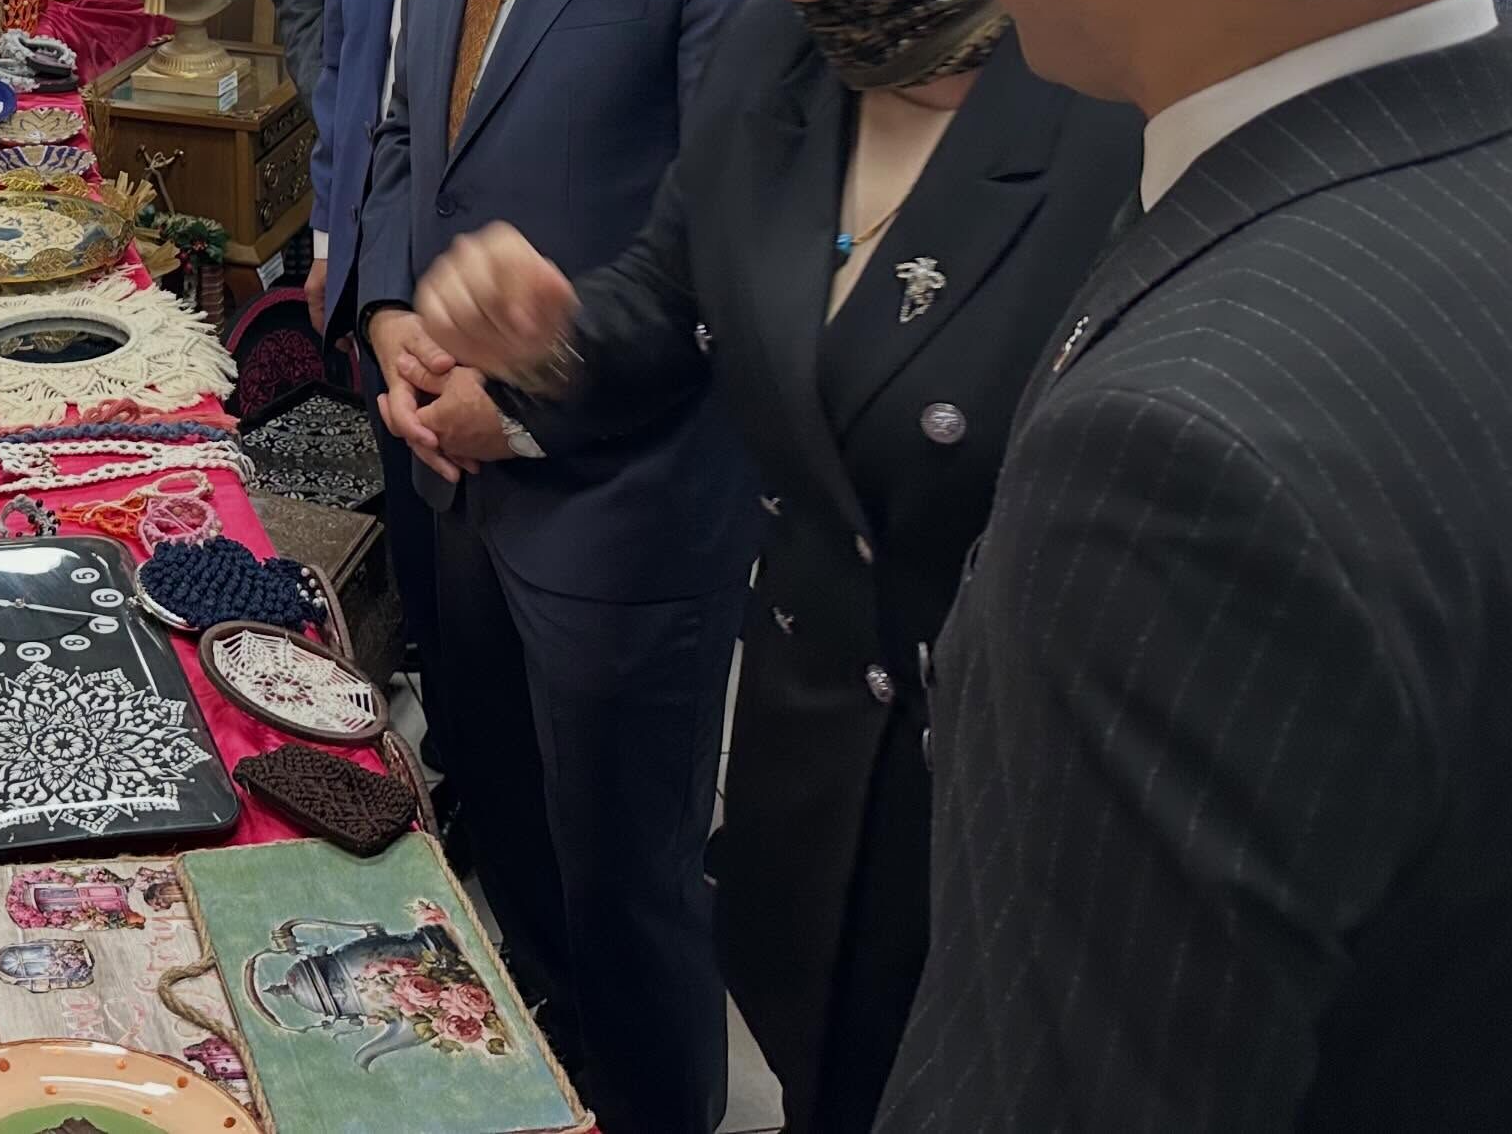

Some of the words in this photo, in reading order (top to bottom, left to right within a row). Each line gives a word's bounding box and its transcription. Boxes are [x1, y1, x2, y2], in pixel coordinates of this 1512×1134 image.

[76, 570, 96, 581] 5
[96, 593, 118, 605] 6
[93, 621, 115, 631] 7
[64, 637, 86, 647] 8
[21, 646, 46, 657] 9
